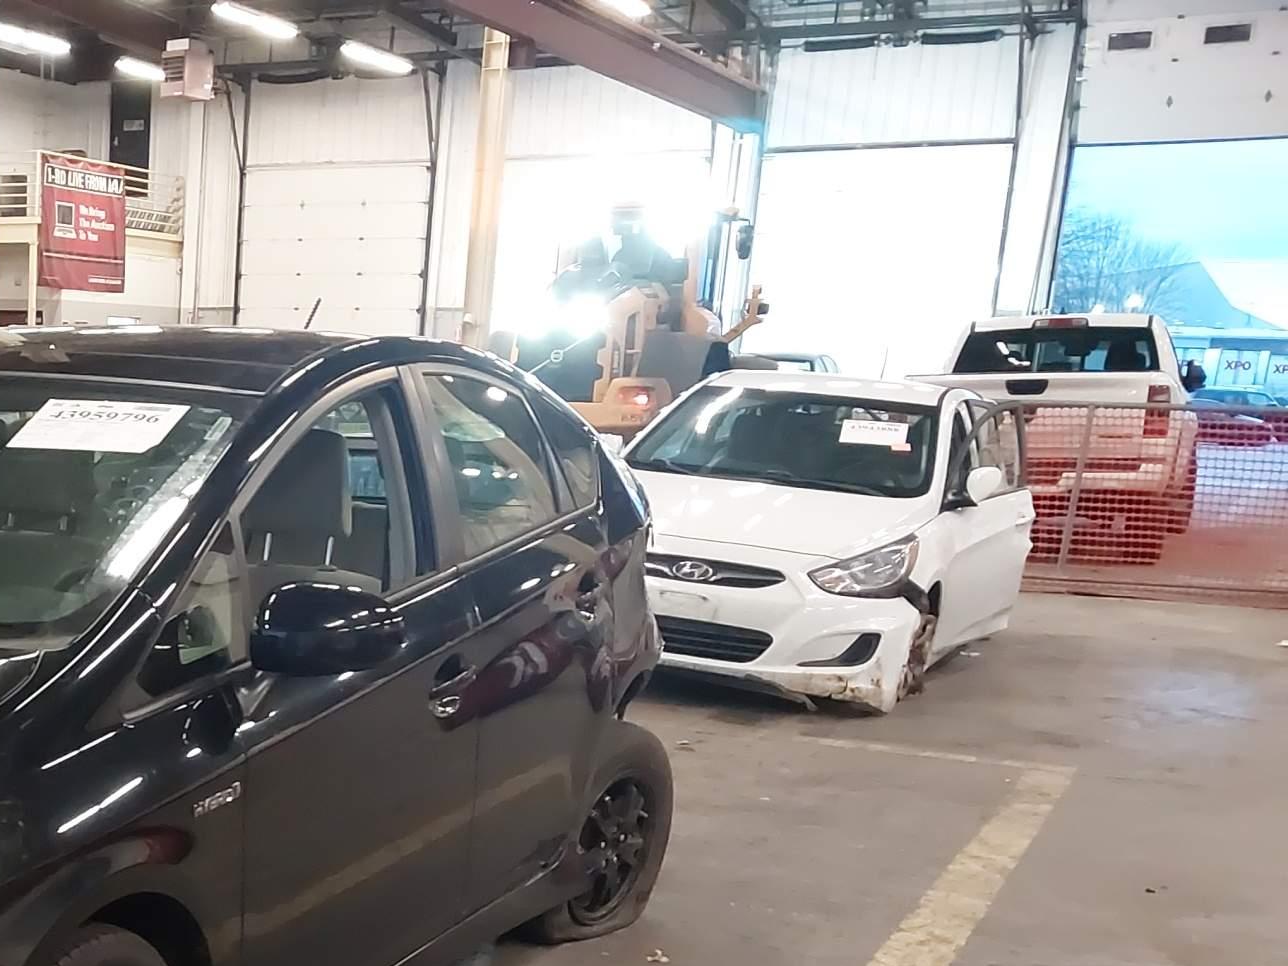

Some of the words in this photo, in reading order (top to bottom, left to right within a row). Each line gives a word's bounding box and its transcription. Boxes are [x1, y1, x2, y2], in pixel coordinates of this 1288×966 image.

[68, 171, 84, 188] LIVE
[85, 174, 107, 191] FROM
[1224, 359, 1252, 371] XPO
[50, 410, 161, 423] 43959796
